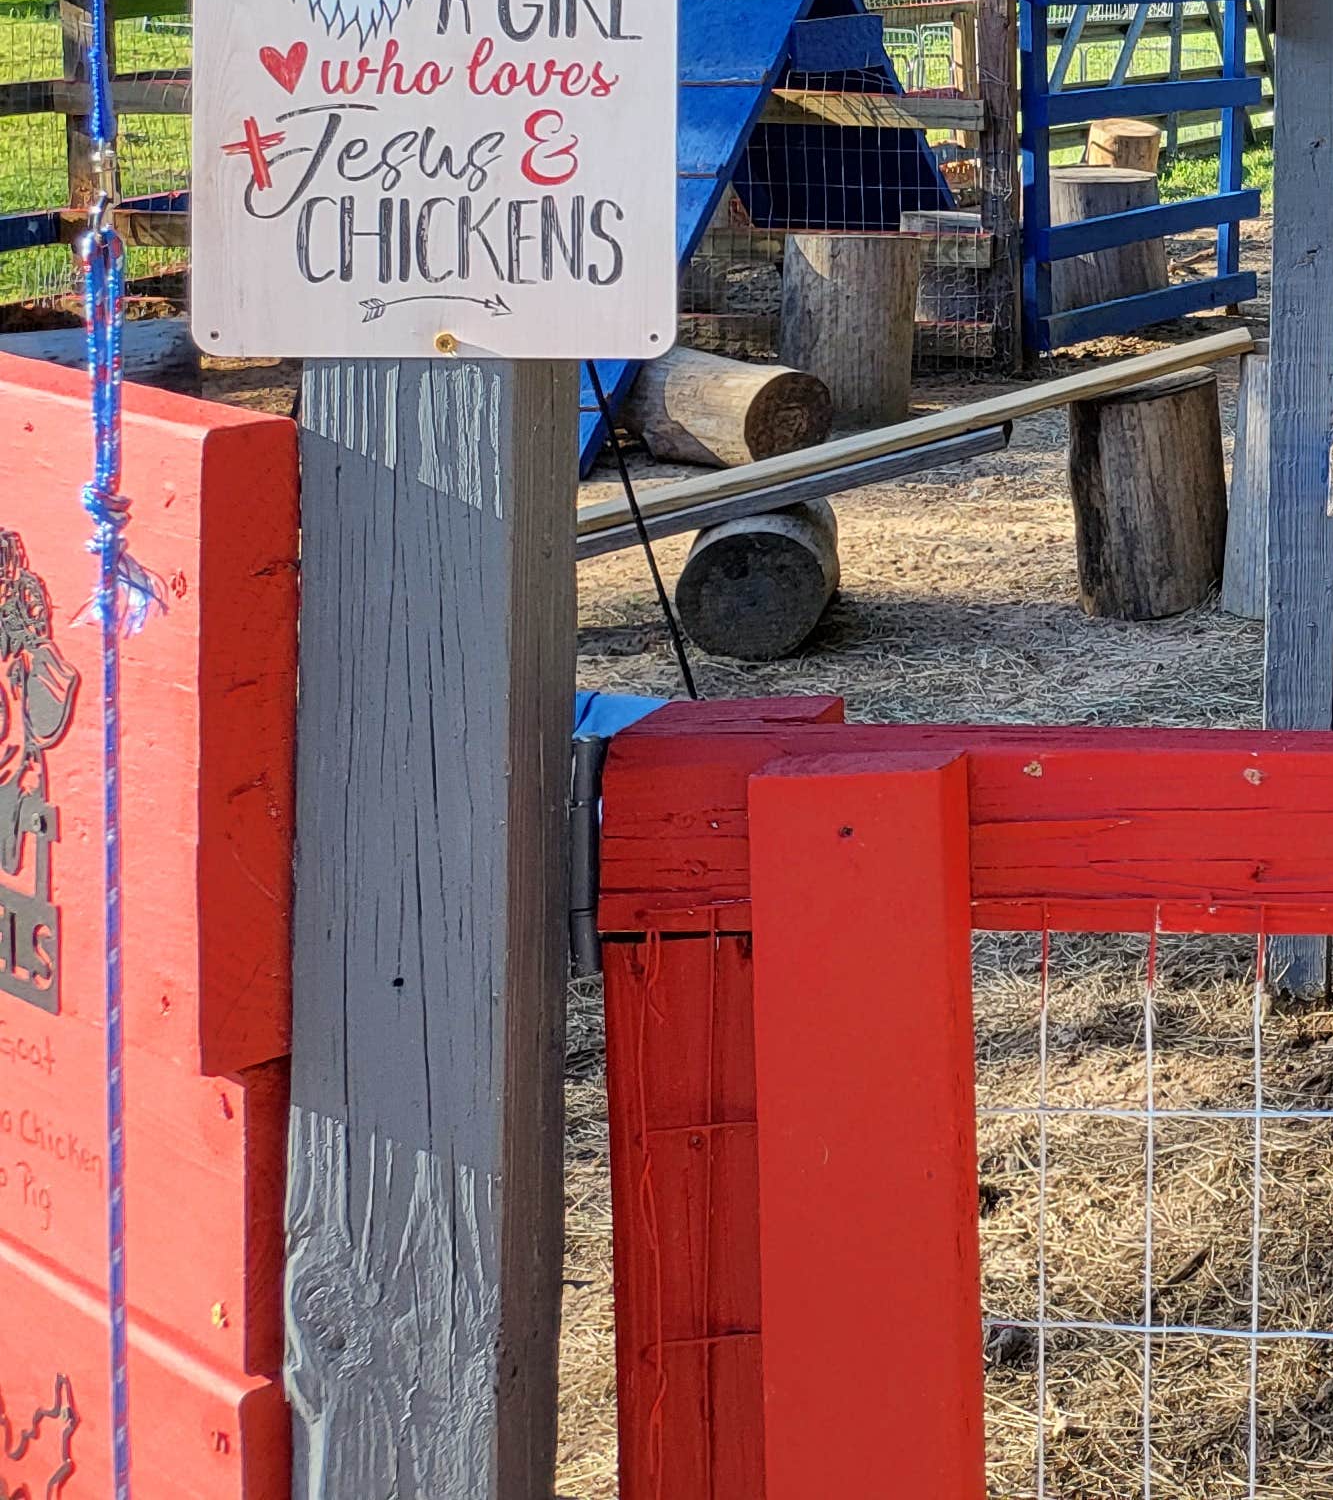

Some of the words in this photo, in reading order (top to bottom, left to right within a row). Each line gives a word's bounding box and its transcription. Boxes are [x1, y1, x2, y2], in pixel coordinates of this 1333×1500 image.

[320, 40, 454, 95] who
[467, 36, 619, 97] loves
[244, 103, 506, 219] Jesus
[520, 108, 578, 185] &
[295, 194, 624, 285] CHICKENS
[0, 904, 53, 991] LS
[15, 1161, 51, 1231] Pig
